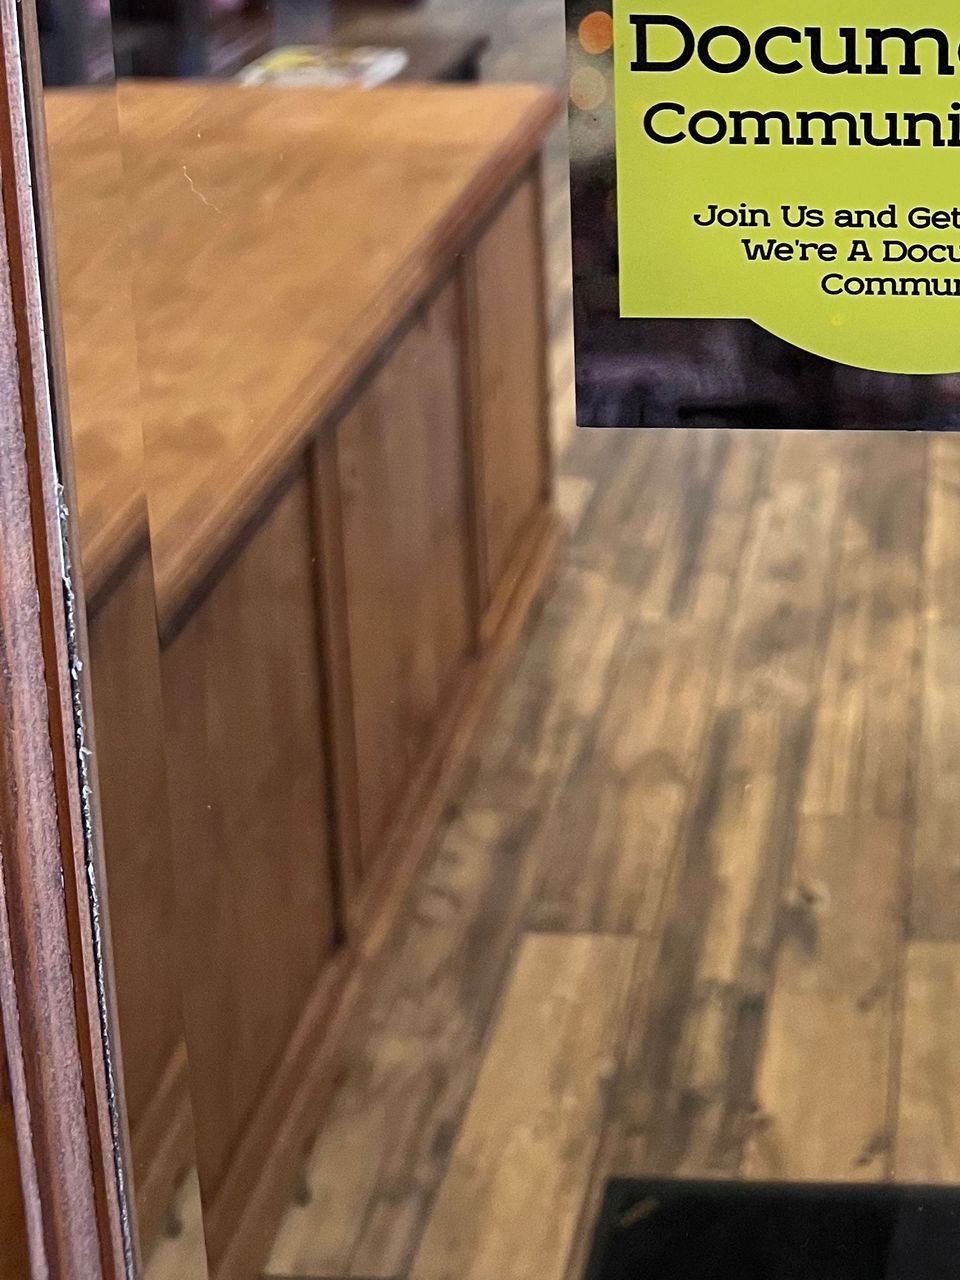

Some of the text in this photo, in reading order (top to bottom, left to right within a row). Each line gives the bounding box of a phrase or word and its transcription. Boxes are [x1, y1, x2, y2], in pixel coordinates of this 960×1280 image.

[693, 203, 771, 227] Join
[780, 205, 825, 228] Us
[834, 204, 898, 229] and
[740, 238, 838, 262] We're
[846, 239, 873, 262] A
